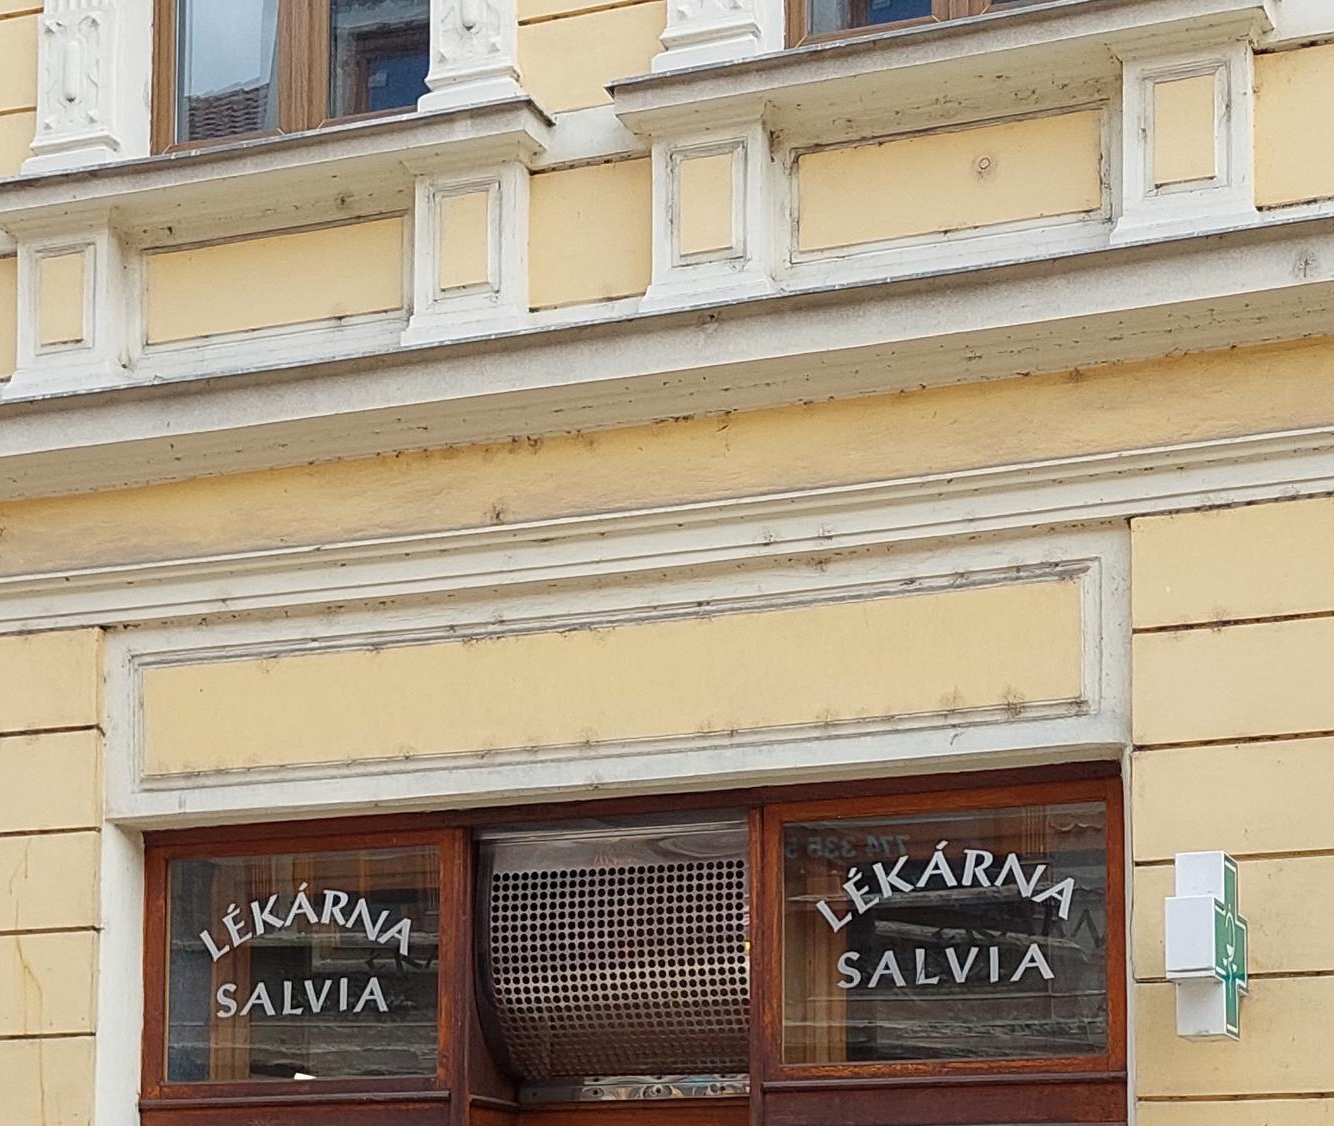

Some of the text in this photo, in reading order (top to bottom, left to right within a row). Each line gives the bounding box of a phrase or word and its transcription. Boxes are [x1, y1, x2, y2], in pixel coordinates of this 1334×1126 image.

[815, 839, 1076, 933] LÉKÁRNA
[199, 881, 415, 964] LÉKÁRNA
[215, 976, 390, 1019] SALVIA
[836, 943, 1055, 989] SALVIA
